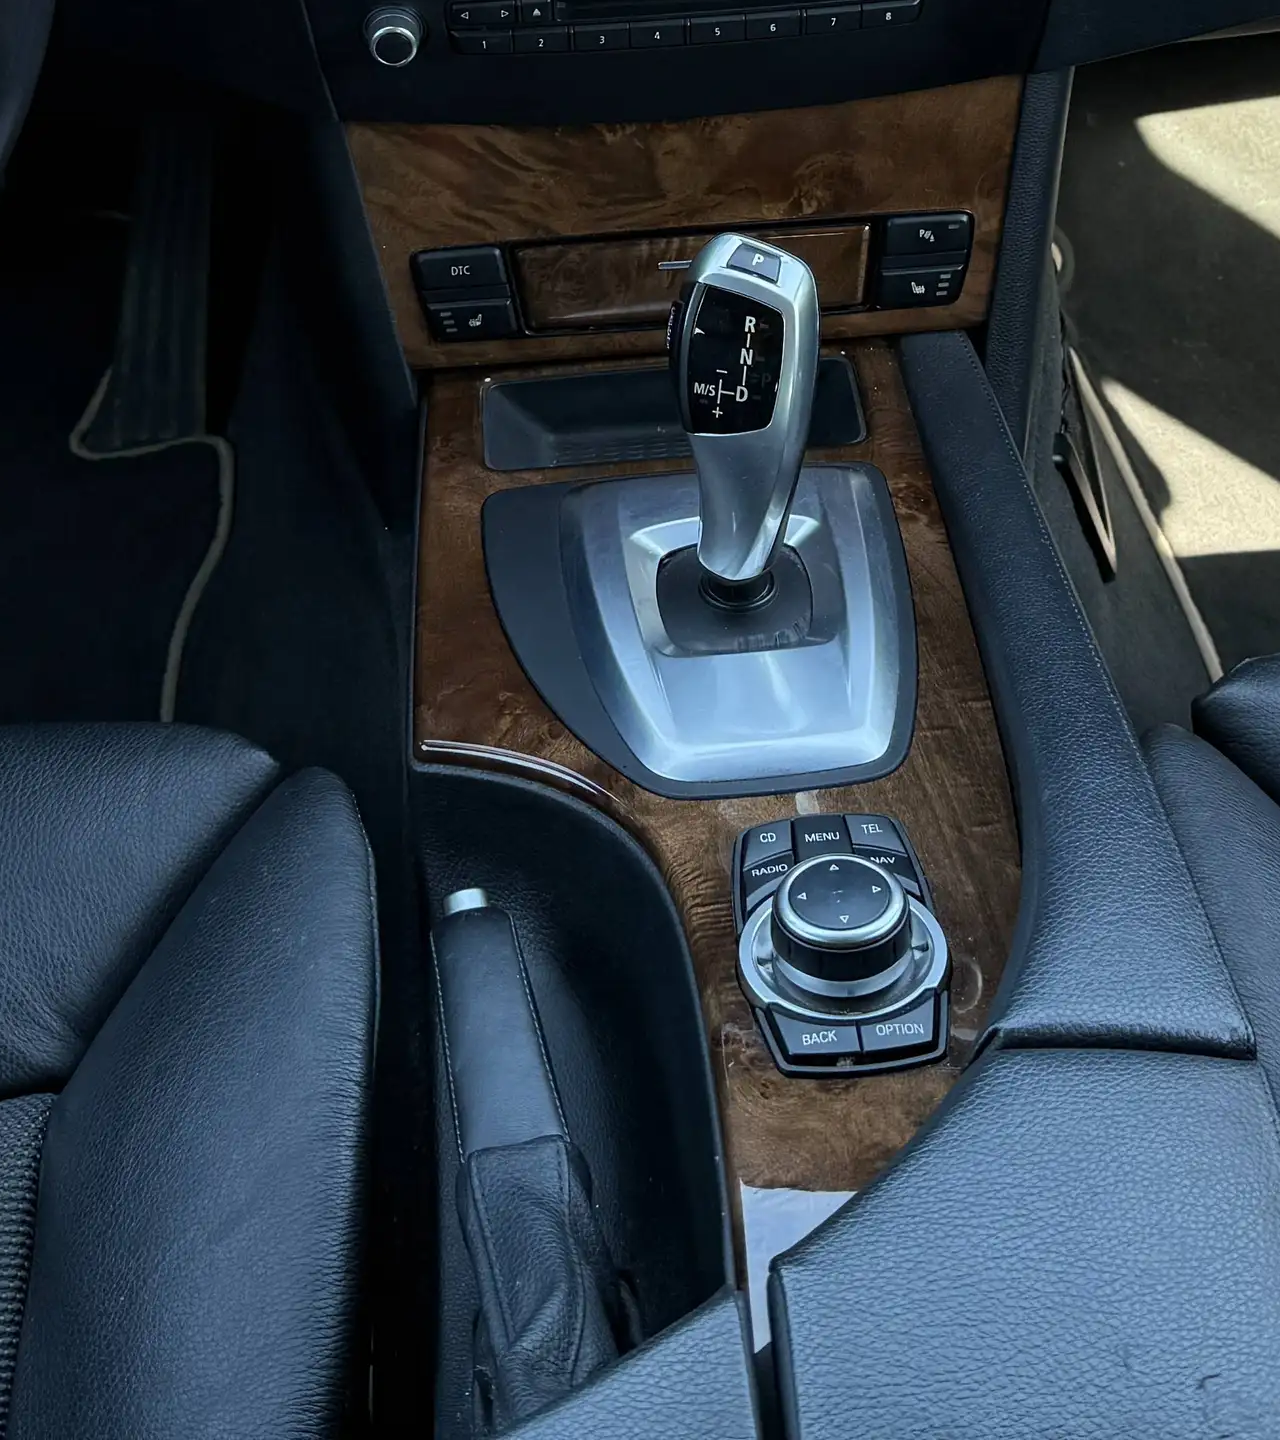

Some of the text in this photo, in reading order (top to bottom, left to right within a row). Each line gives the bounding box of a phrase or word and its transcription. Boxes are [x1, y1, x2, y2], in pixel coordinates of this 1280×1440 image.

[831, 17, 836, 26] 7
[886, 12, 892, 21] 8
[715, 27, 720, 36] 5
[770, 23, 776, 32] 6
[599, 35, 605, 44] 3
[654, 31, 660, 40] 4
[482, 40, 487, 48] 1
[538, 38, 544, 47] 2
[752, 254, 764, 266] P
[451, 264, 470, 276] DTC
[744, 316, 756, 333] R
[740, 348, 754, 366] N
[694, 381, 716, 397] M/S
[735, 385, 749, 402] D
[861, 823, 883, 835] TEL
[759, 832, 776, 843] CD
[805, 831, 840, 843] MENU
[870, 855, 895, 865] NAV
[751, 863, 788, 878] RADIO
[876, 1023, 924, 1037] OPTION
[802, 1030, 838, 1046] BACK
